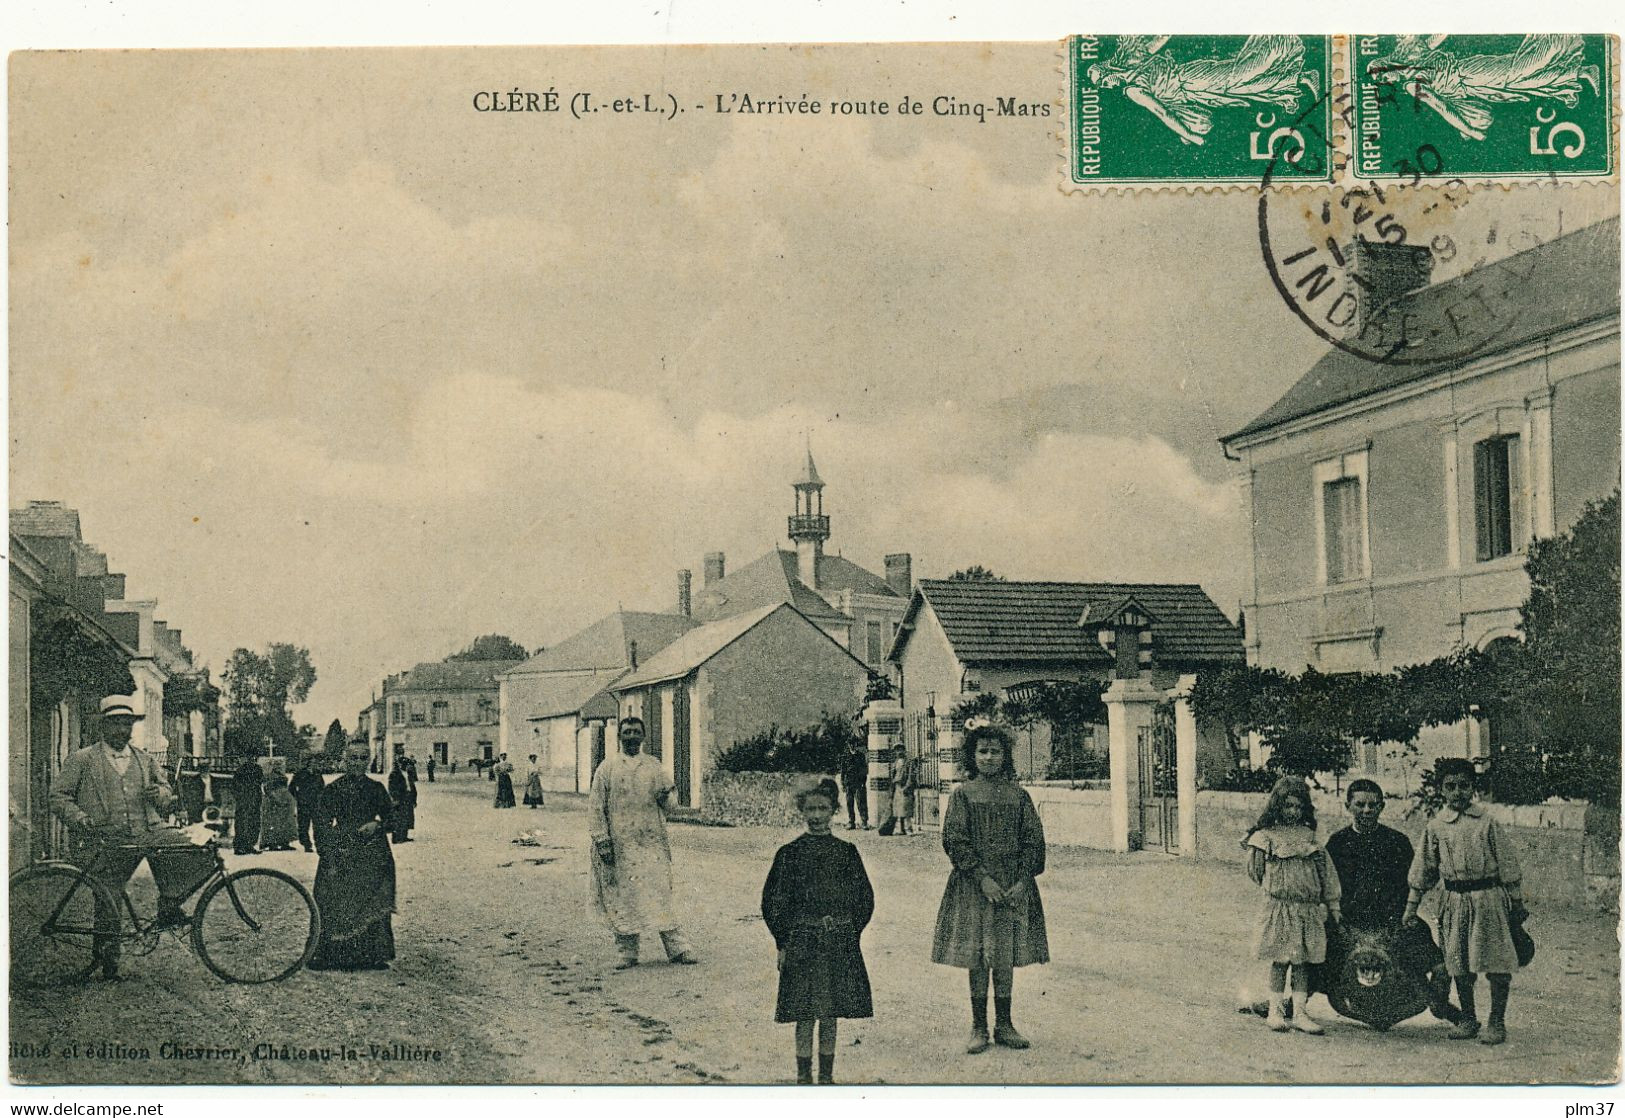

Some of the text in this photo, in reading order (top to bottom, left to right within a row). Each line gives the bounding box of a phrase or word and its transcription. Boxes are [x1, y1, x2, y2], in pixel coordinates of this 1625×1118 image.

[473, 86, 560, 112] CLÉRÉ
[570, 92, 685, 121] (I.-et-L.).
[715, 93, 822, 115] L'Arrivée
[830, 99, 890, 115] route
[897, 95, 923, 115] de
[932, 96, 1051, 124] Cinq-Mars
